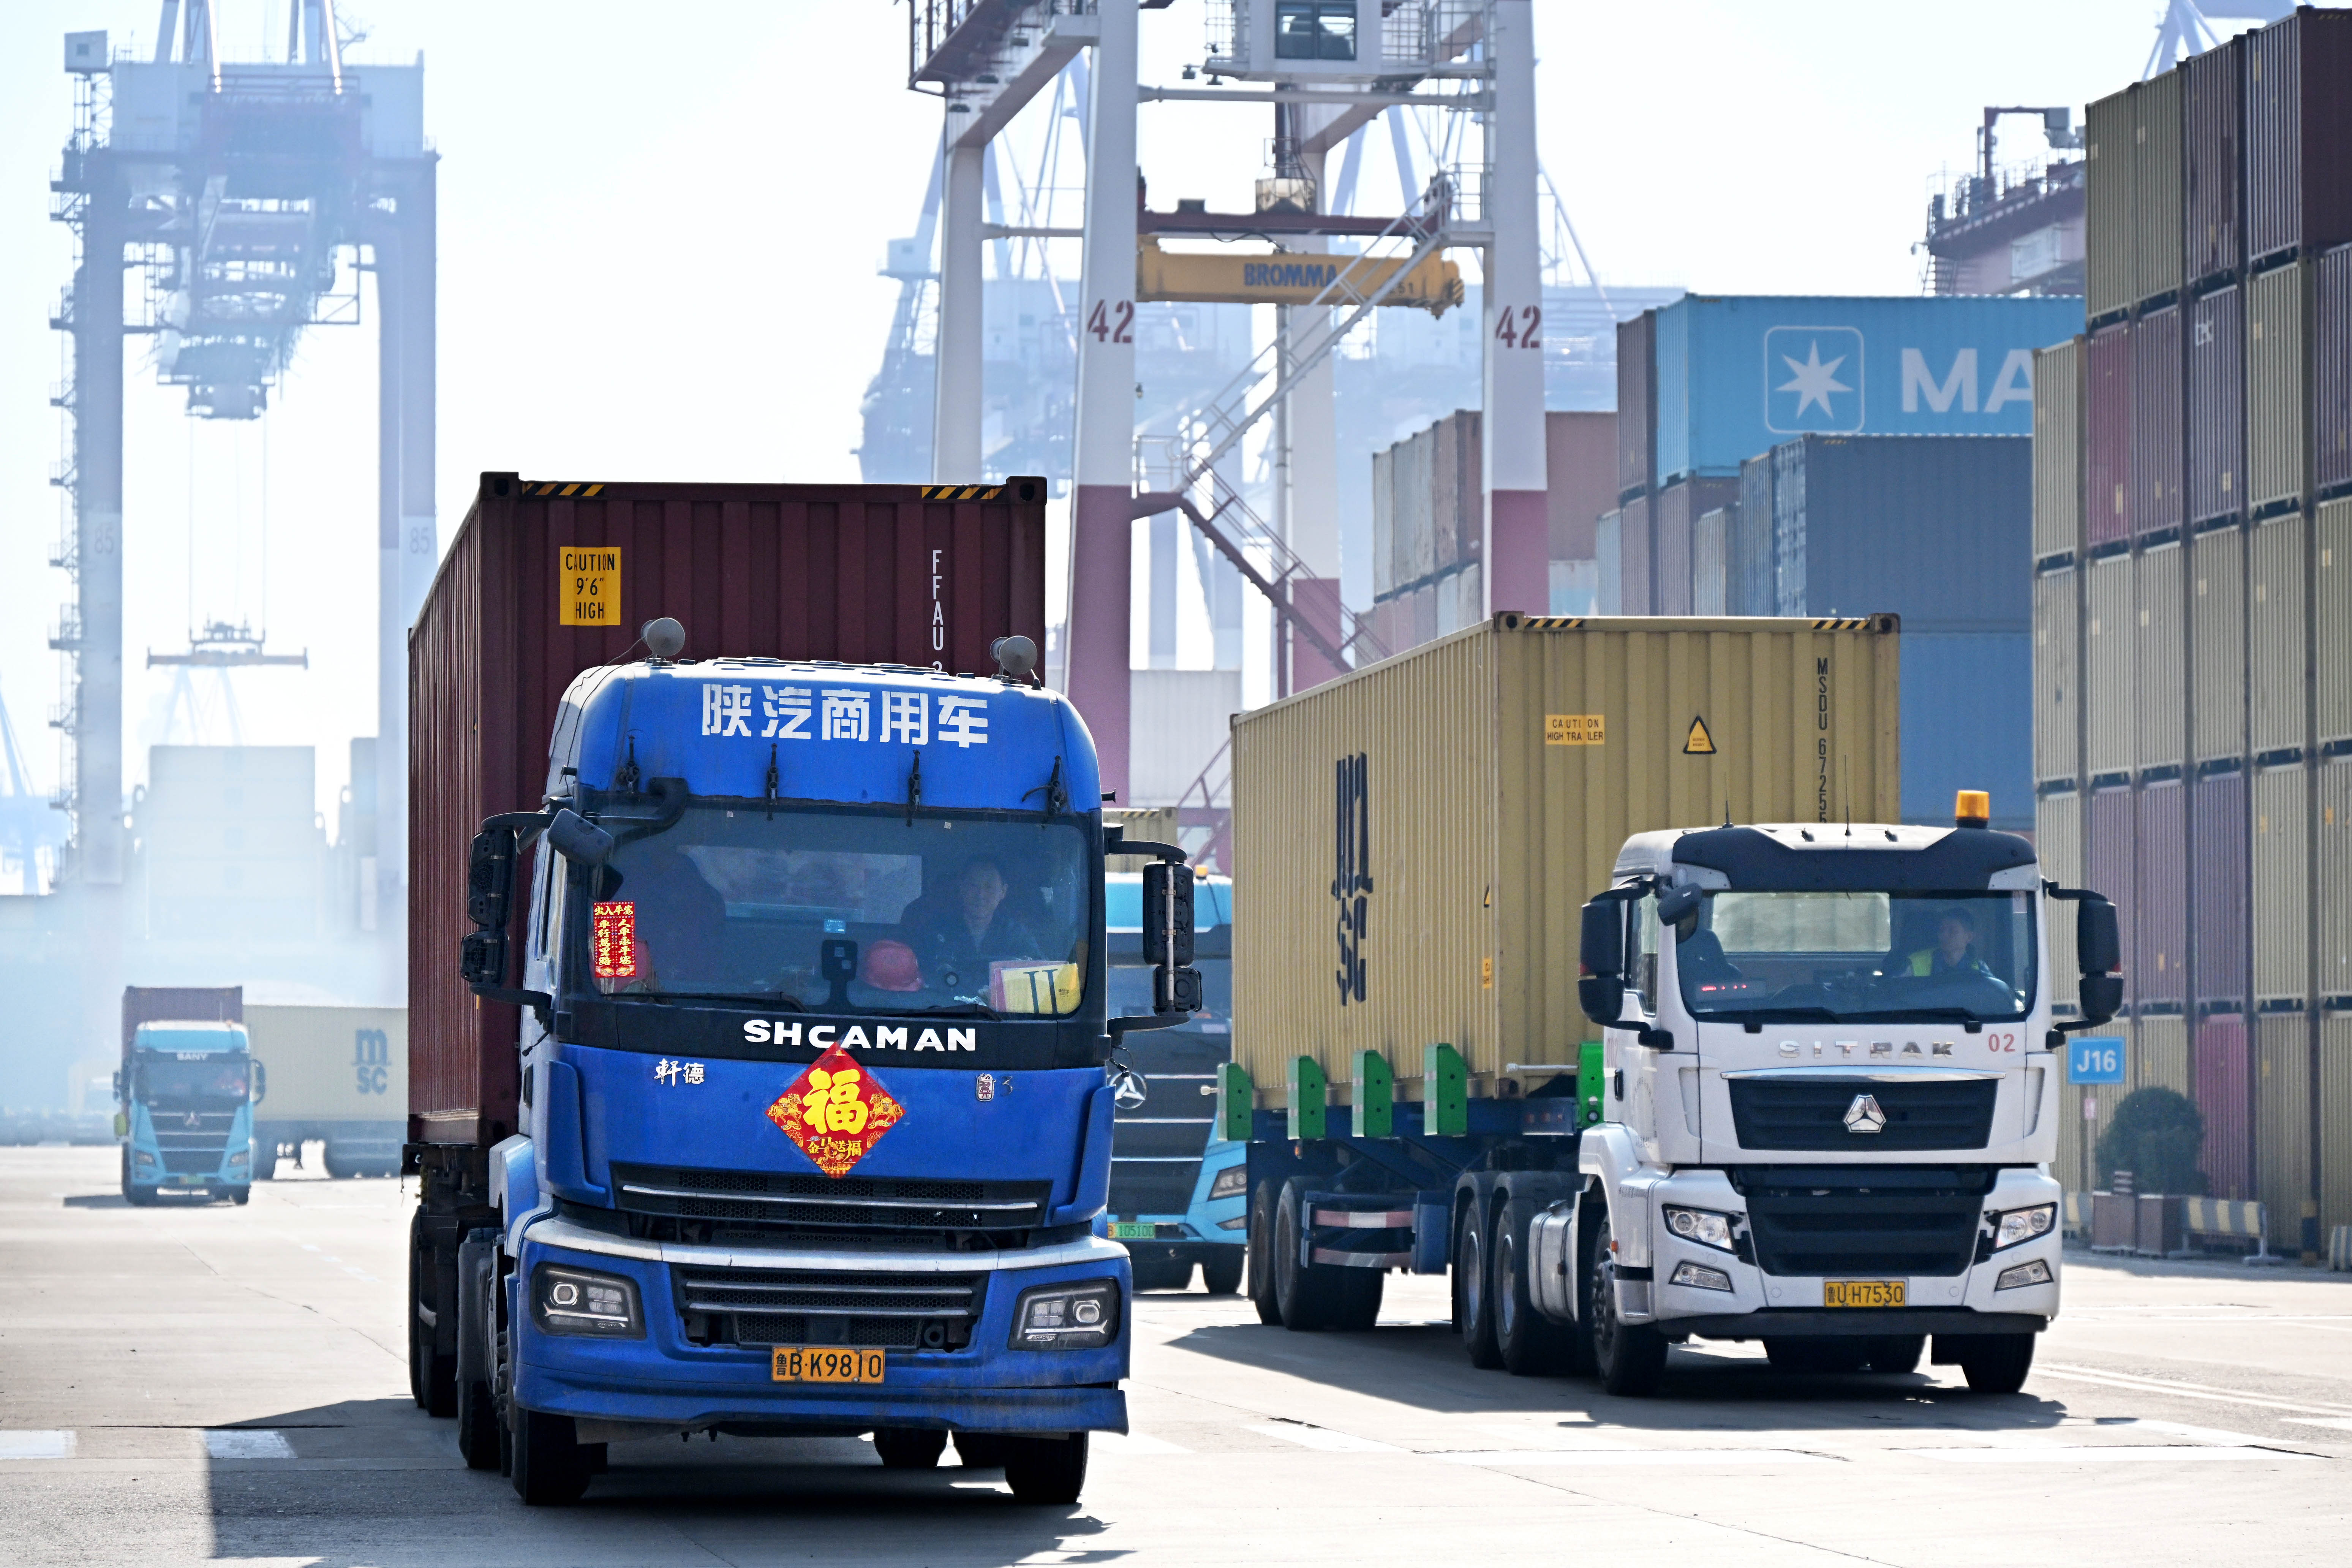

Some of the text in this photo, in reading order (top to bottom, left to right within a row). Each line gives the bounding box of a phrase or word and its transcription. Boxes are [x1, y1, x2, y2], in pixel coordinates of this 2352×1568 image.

[1244, 263, 1338, 287] BROMMA
[1087, 299, 1134, 343] 42
[1496, 305, 1541, 348] 42
[410, 526, 430, 555] 85
[566, 553, 615, 571] CAUTION
[575, 602, 604, 619] HIGH
[1818, 658, 1828, 730] MSDU
[702, 684, 988, 748] 陕汽商用车
[1552, 719, 1599, 729] CAUTION
[1547, 732, 1603, 741] HIGH TRAILER
[594, 904, 634, 916] 出入平安
[743, 1019, 976, 1051] SHCAMAN
[1778, 1034, 2015, 1059] SITRAK 02
[2077, 1050, 2117, 1072] J16
[802, 1068, 869, 1135] 福
